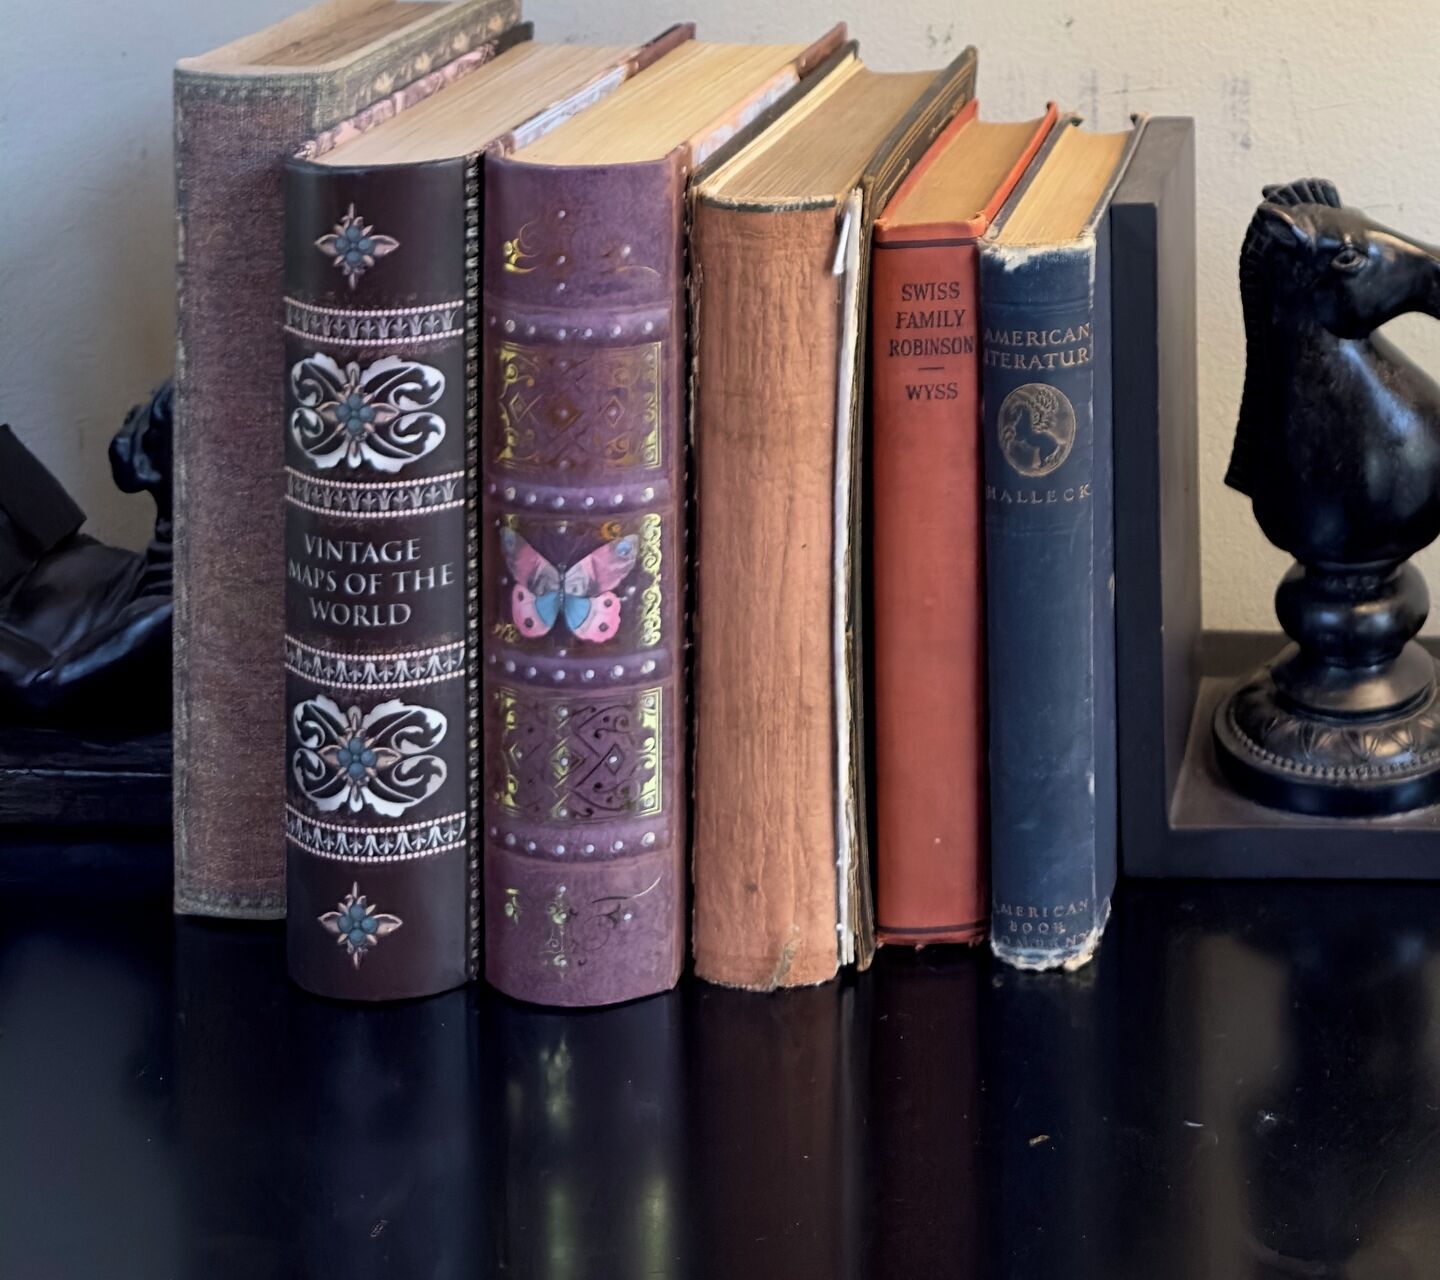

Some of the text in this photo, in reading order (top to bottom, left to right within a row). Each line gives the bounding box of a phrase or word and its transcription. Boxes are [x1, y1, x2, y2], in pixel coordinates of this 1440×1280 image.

[901, 281, 961, 302] SWISS
[895, 308, 967, 330] FAMILY
[983, 321, 1090, 347] AMERICAN
[889, 335, 975, 357] ROBINSON
[984, 346, 1090, 370] ITERATUR
[905, 382, 959, 401] WYSS
[985, 483, 1091, 505] HALLECK
[304, 533, 420, 564] VINTAGE
[287, 557, 456, 595] MAPS OF THE
[308, 596, 412, 627] WORLD
